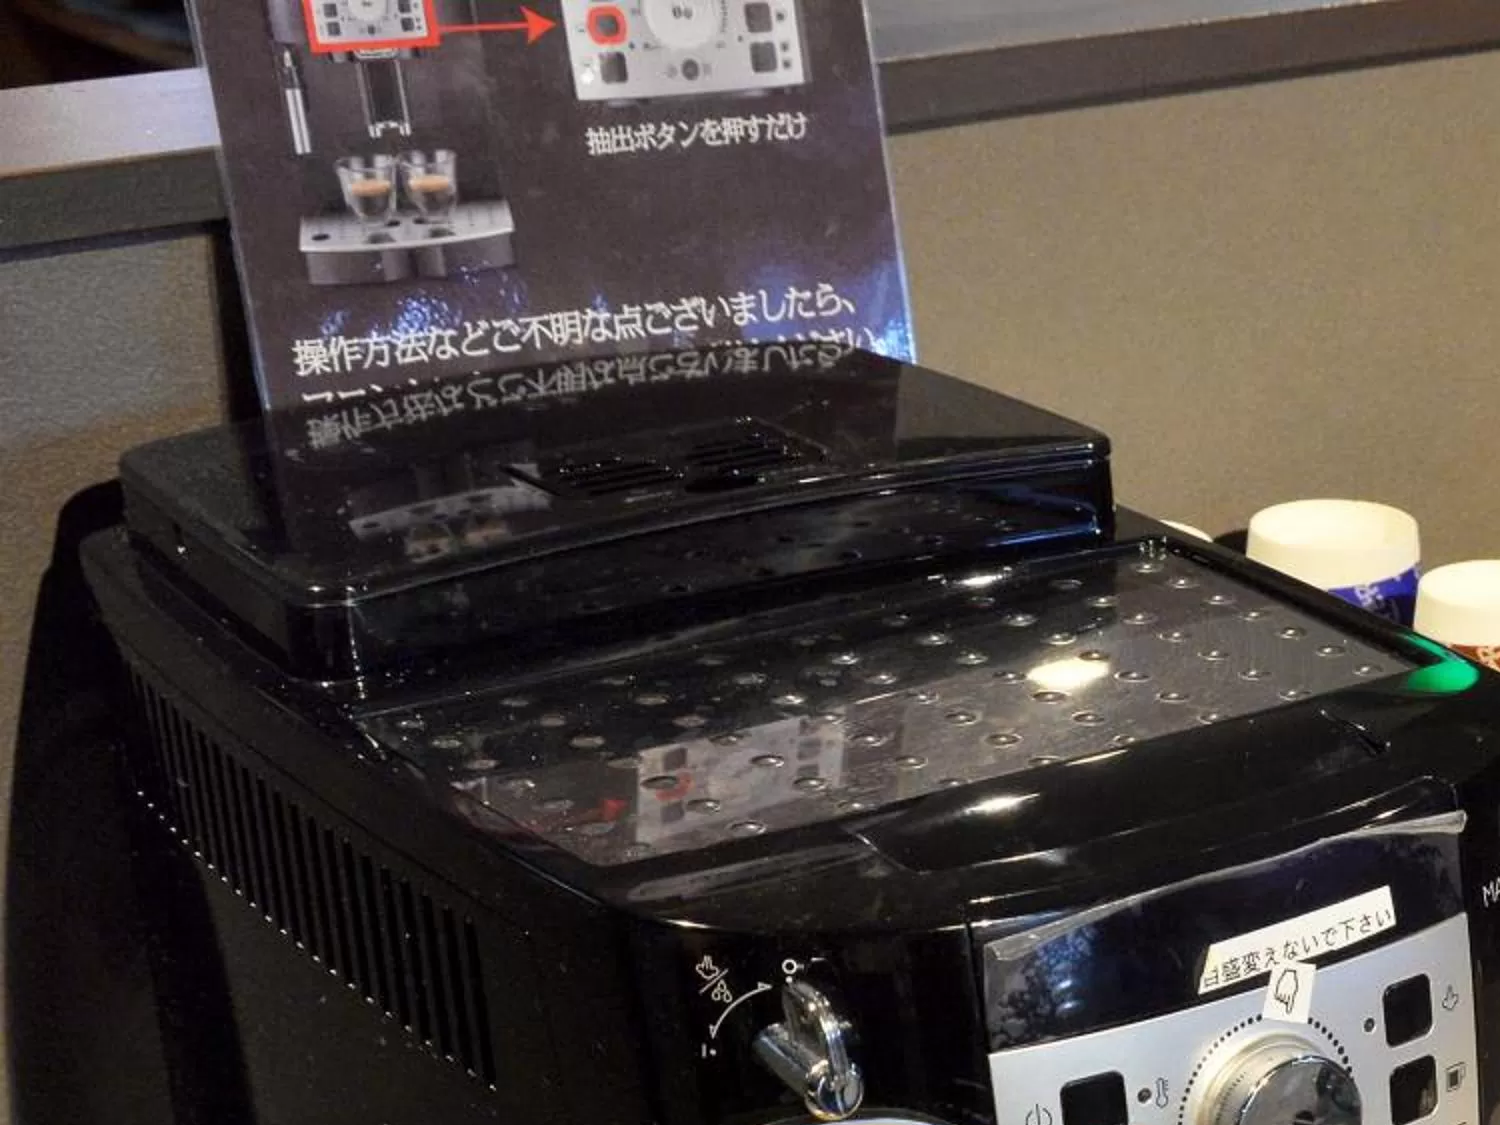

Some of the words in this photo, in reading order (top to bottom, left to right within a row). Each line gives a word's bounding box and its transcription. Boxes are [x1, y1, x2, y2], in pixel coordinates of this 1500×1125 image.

[585, 111, 809, 156] 抽出ボタンを押すだけ
[292, 283, 856, 377] 操作方法などご不明な点ございましたら、
